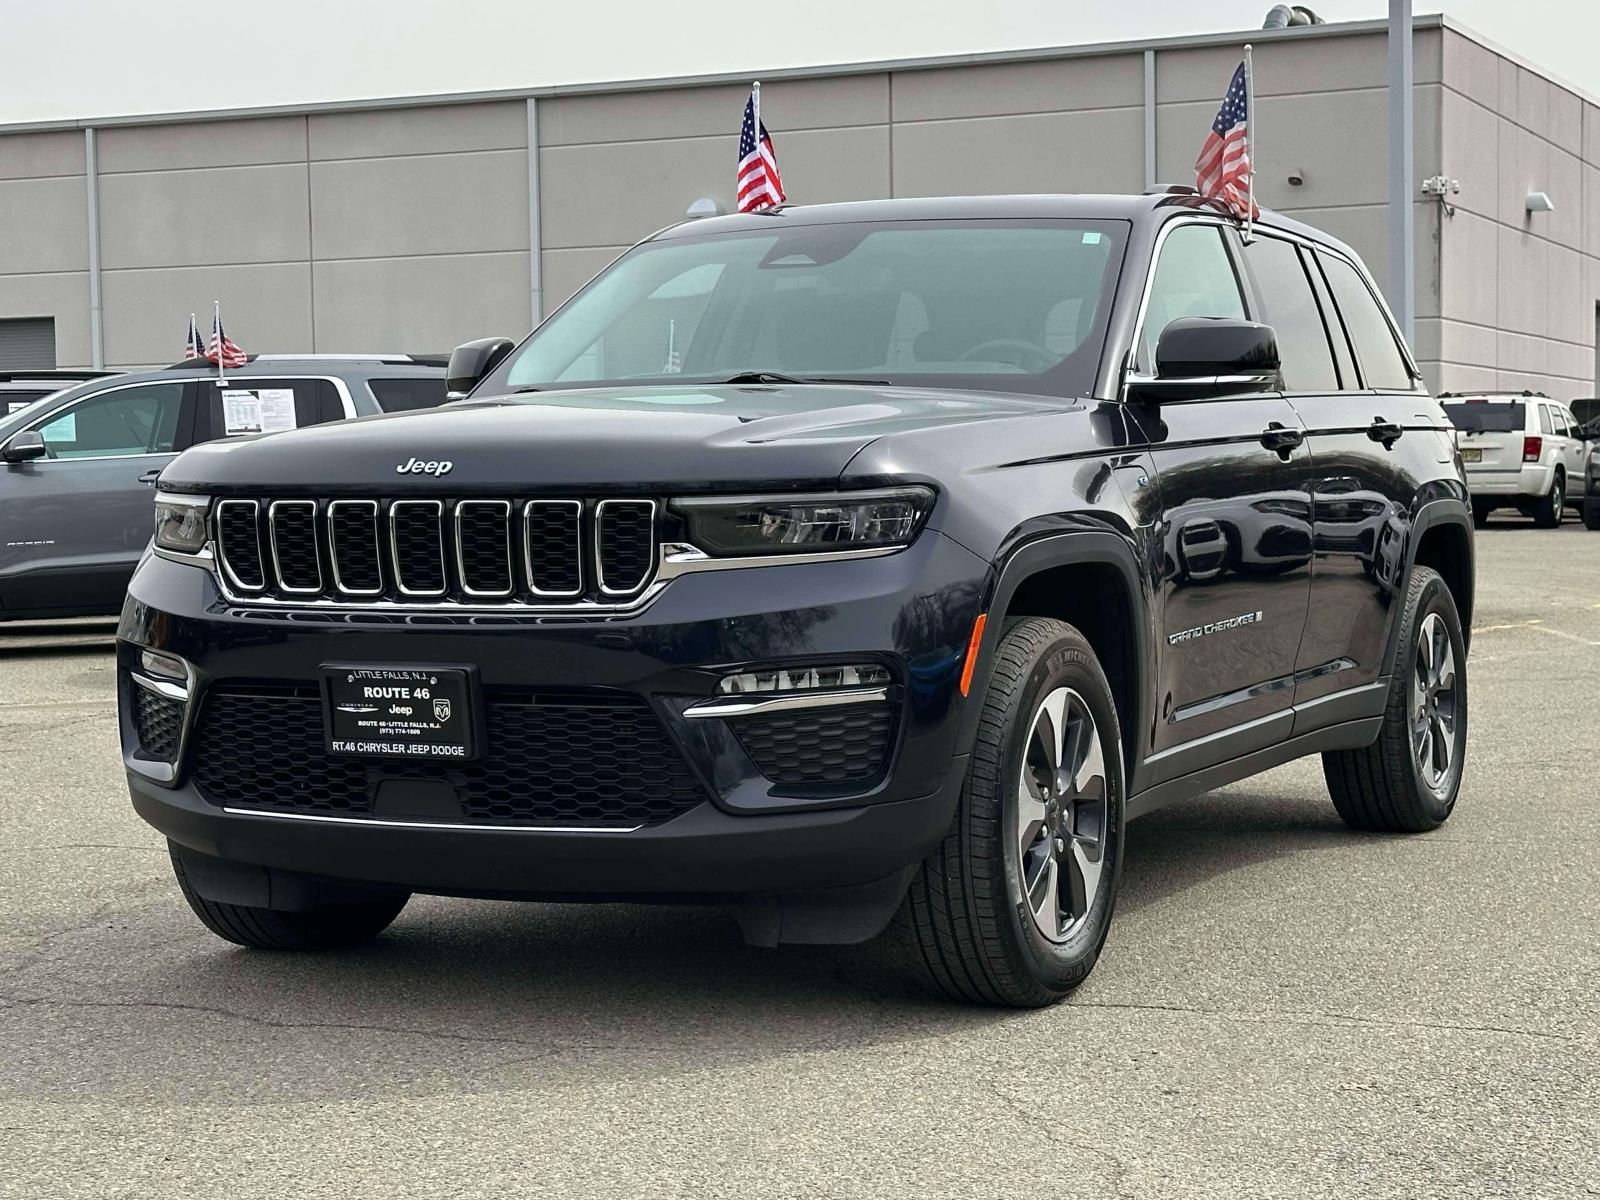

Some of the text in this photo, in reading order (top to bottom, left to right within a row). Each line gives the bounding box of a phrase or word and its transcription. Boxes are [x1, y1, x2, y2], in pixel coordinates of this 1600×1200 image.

[396, 457, 453, 476] Jeep
[1168, 613, 1255, 645] GRAND CHEROKEE
[353, 670, 383, 679] LITTLE
[363, 686, 431, 699] ROUTE 46
[388, 703, 413, 716] Jeep
[356, 742, 405, 754] CHRYSLER
[406, 744, 430, 755] JEEP
[431, 745, 465, 756] DODGE
